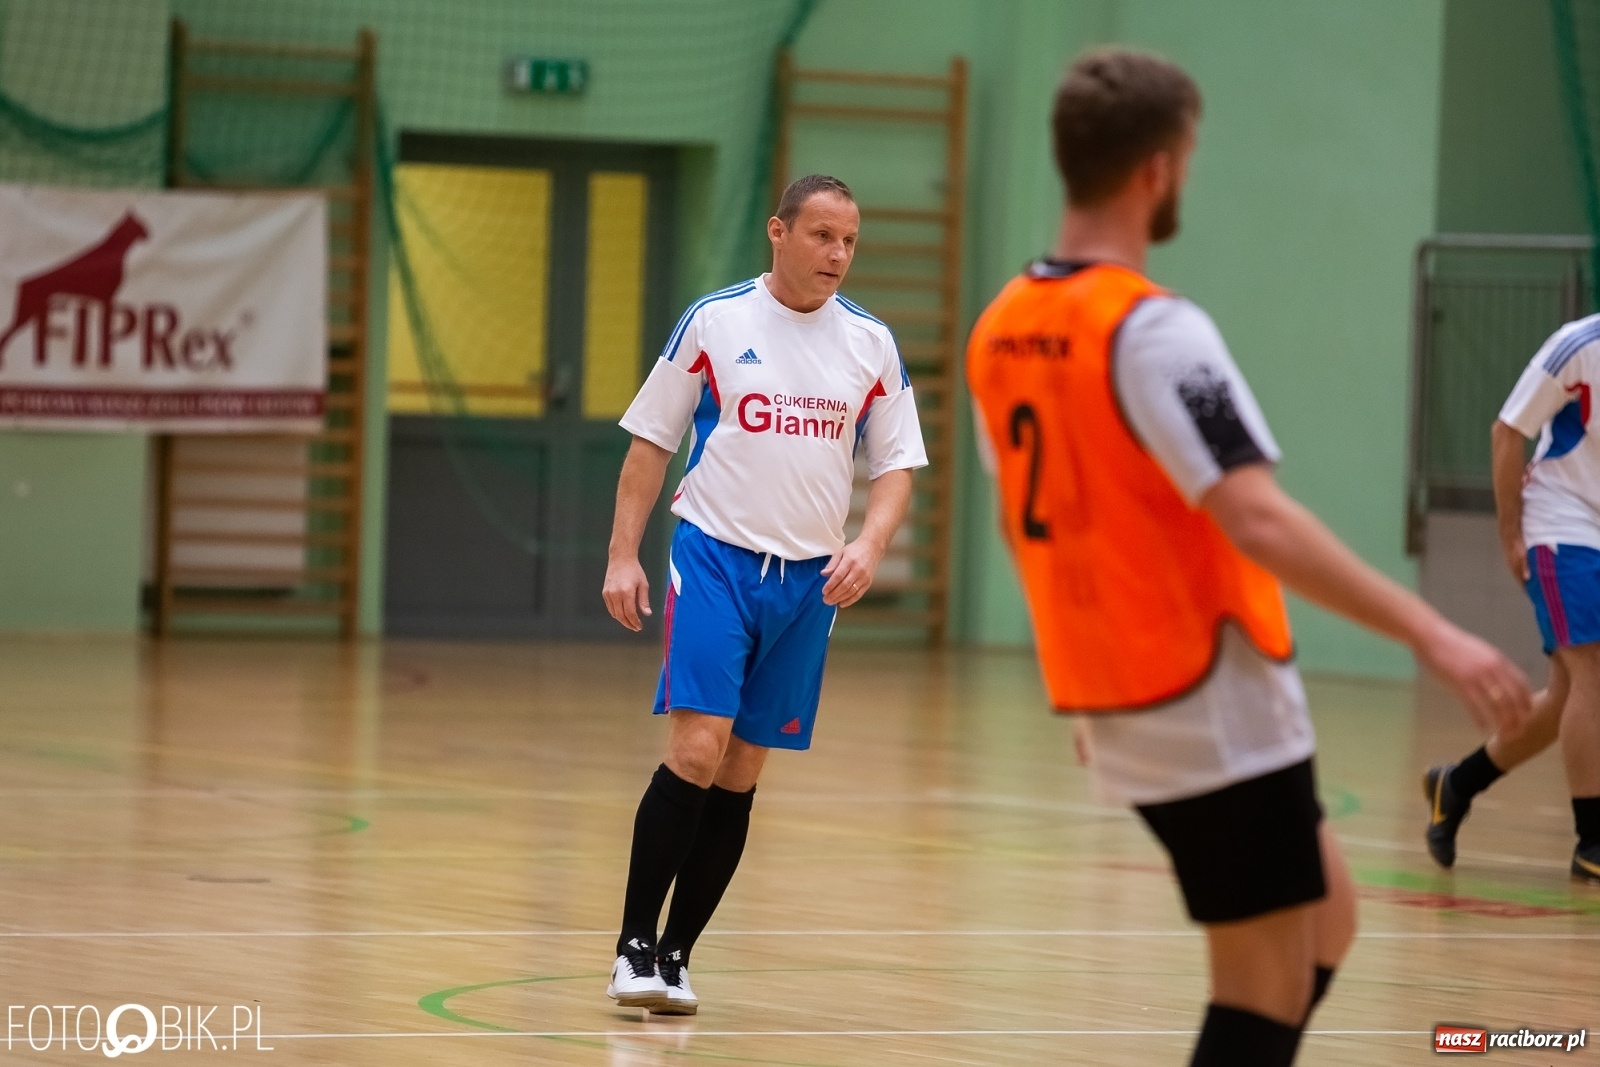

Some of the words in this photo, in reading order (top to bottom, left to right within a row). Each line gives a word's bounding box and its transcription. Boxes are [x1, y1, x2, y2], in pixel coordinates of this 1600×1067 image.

[737, 392, 846, 440] Gianni
[773, 393, 848, 414] CUKIERNIA
[1009, 402, 1053, 540] 2
